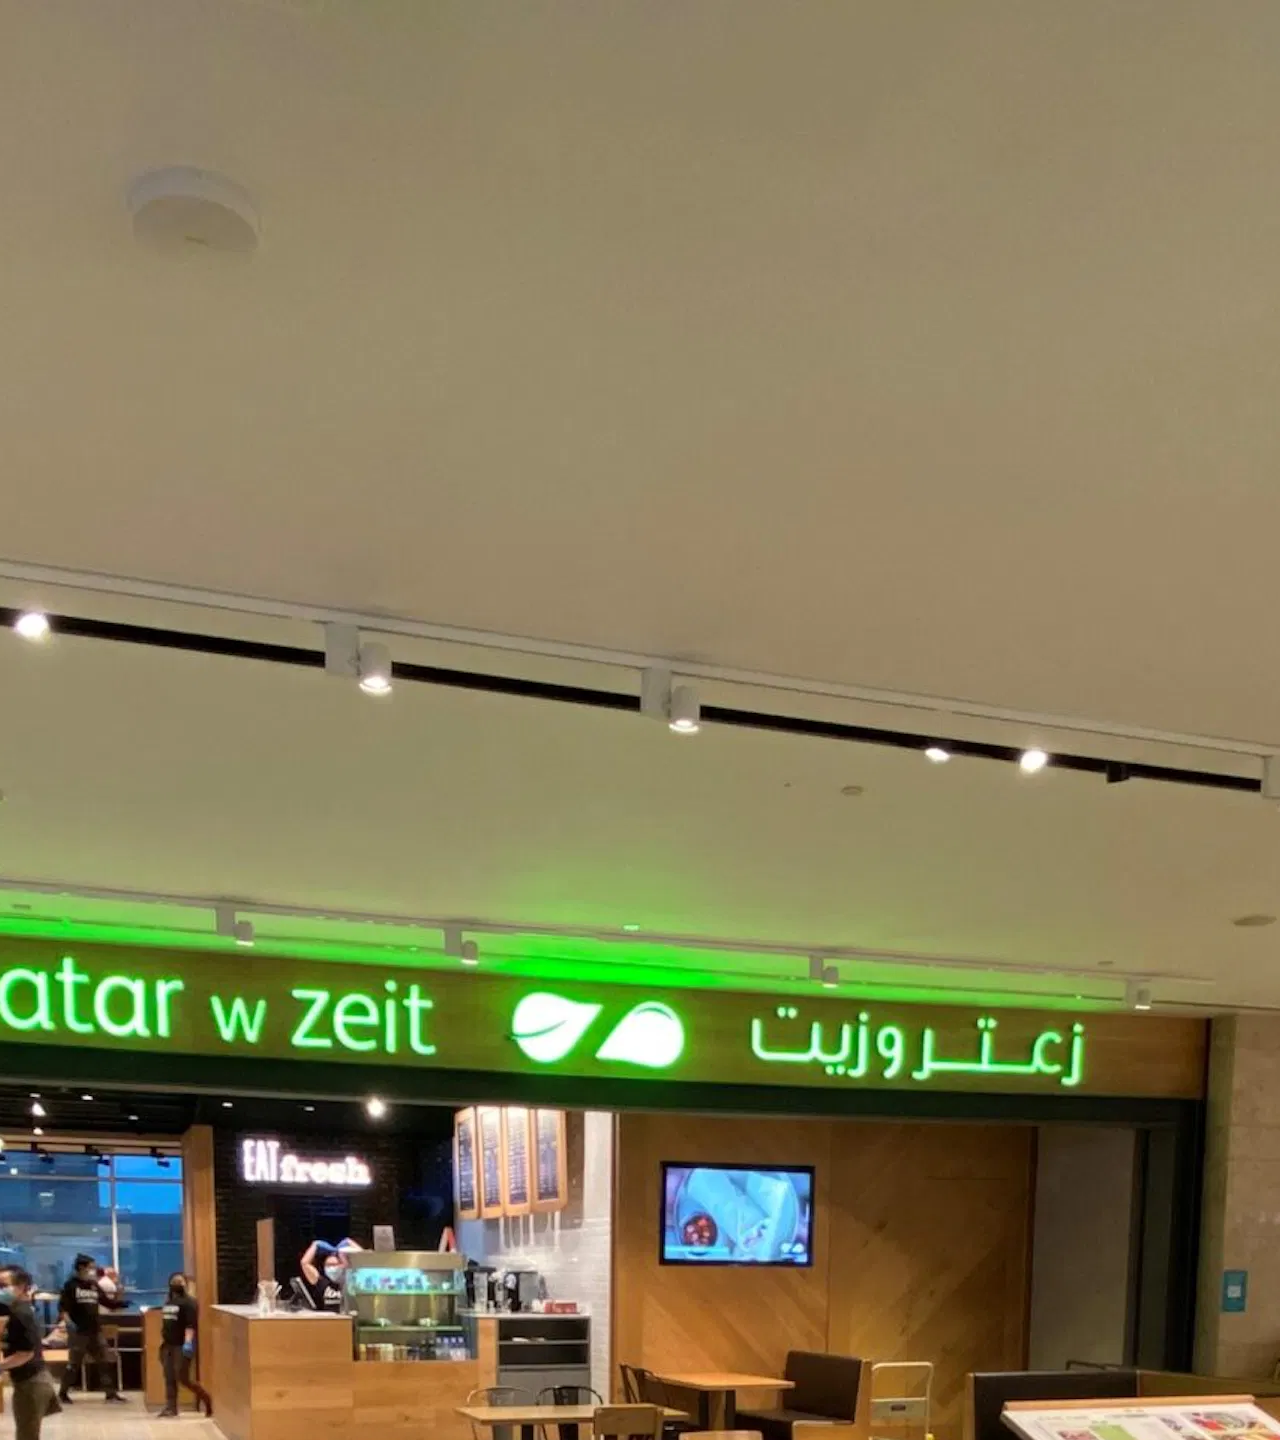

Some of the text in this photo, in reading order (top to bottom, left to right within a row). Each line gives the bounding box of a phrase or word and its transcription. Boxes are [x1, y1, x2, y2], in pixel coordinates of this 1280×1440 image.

[210, 994, 267, 1045] w
[290, 979, 437, 1056] zeit
[241, 1138, 372, 1185] EAT fresh
